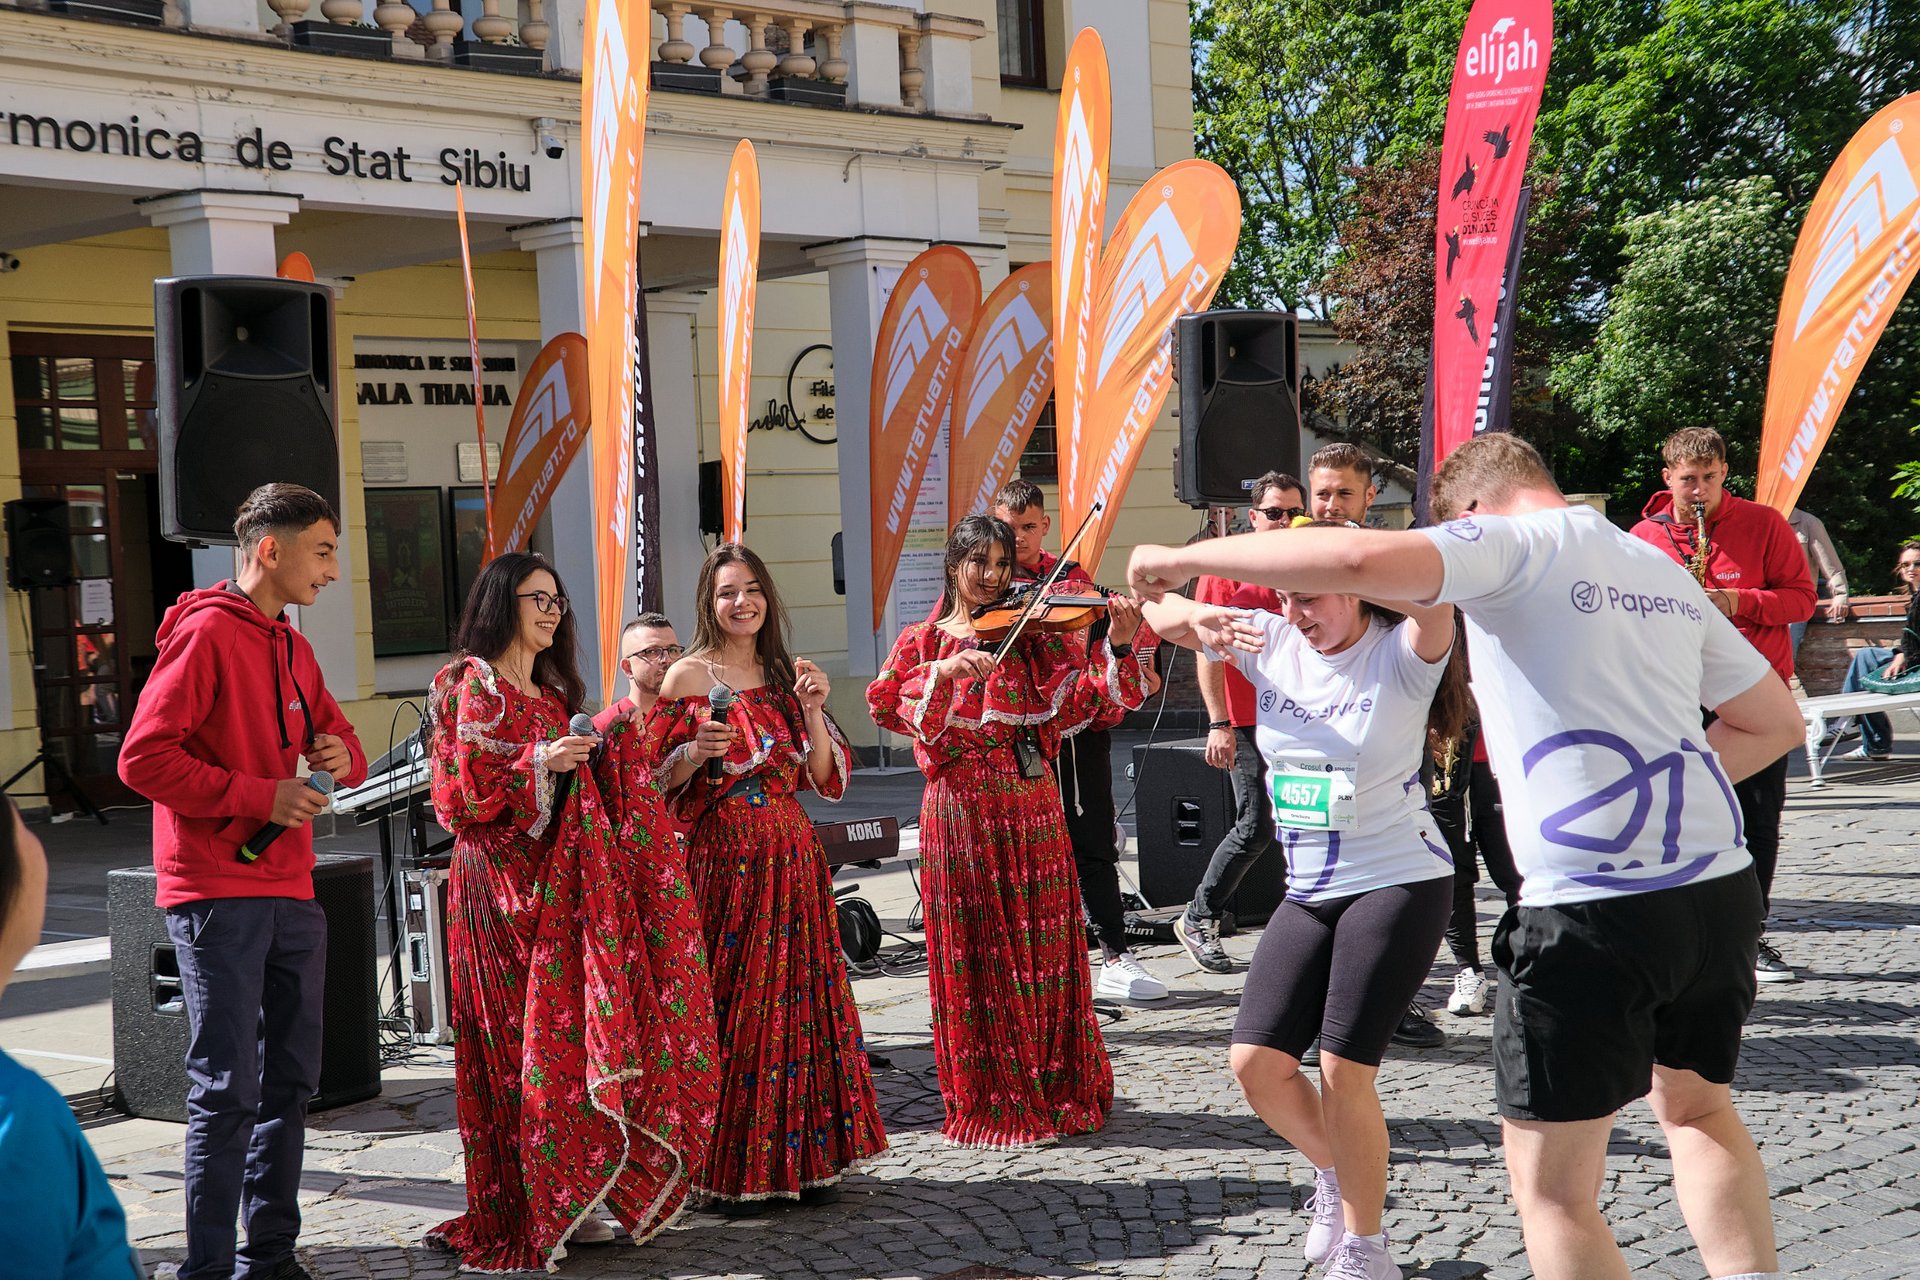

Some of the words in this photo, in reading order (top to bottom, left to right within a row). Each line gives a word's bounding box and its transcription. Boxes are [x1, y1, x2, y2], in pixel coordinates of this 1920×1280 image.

[1466, 28, 1538, 84] elijah
[0, 112, 202, 163] monica
[236, 127, 293, 171] de
[324, 136, 412, 182] Stat
[440, 148, 531, 192] Sibiu
[816, 403, 835, 419] de
[1090, 263, 1209, 520] www.taturo
[886, 325, 962, 535] www.tatuat.ro
[1716, 571, 1741, 581] elijah
[1280, 782, 1322, 807] 4557
[845, 821, 883, 842] KORG
